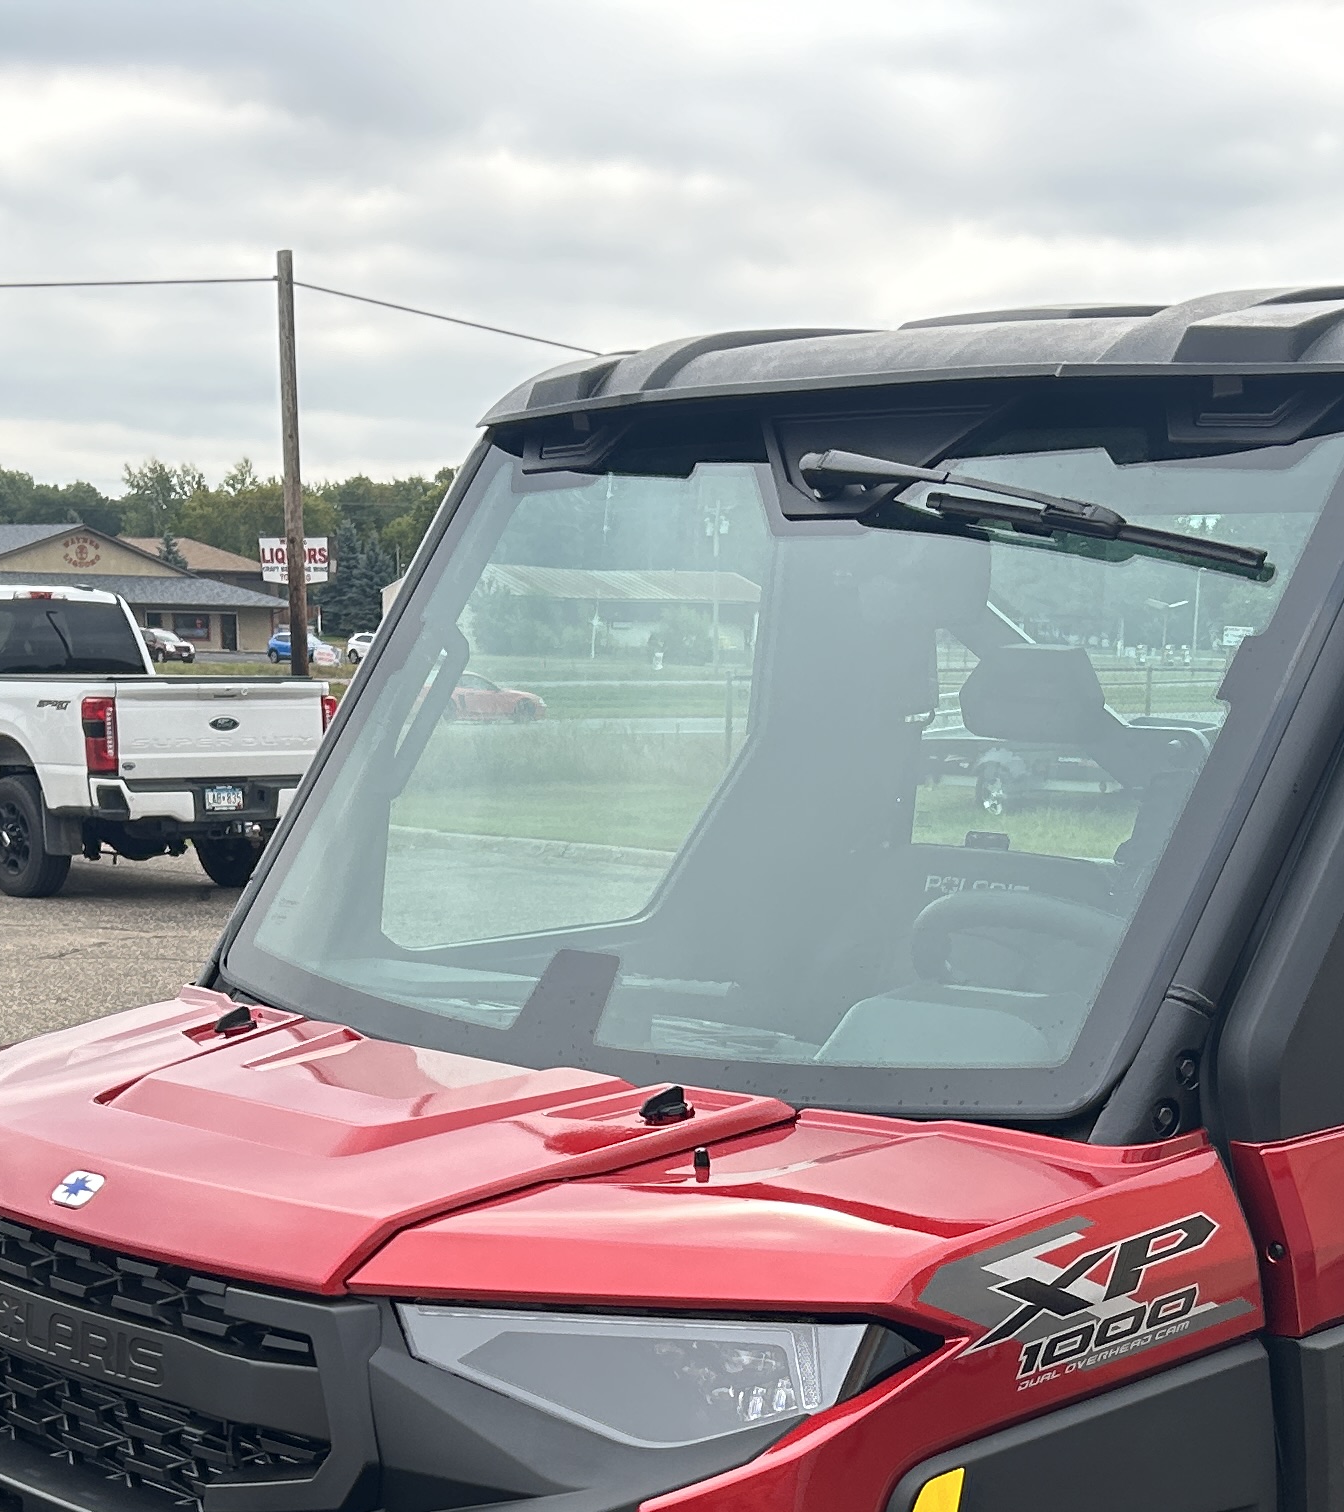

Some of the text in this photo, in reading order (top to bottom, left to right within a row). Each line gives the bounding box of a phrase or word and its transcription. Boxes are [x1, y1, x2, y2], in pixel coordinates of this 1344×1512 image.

[261, 547, 329, 565] LIQRS
[131, 735, 314, 750] SUPER DUTY
[954, 1211, 1220, 1361] XP
[1015, 1282, 1201, 1381] 1000
[1017, 1319, 1191, 1392] DUAL OVERHEAD CAM
